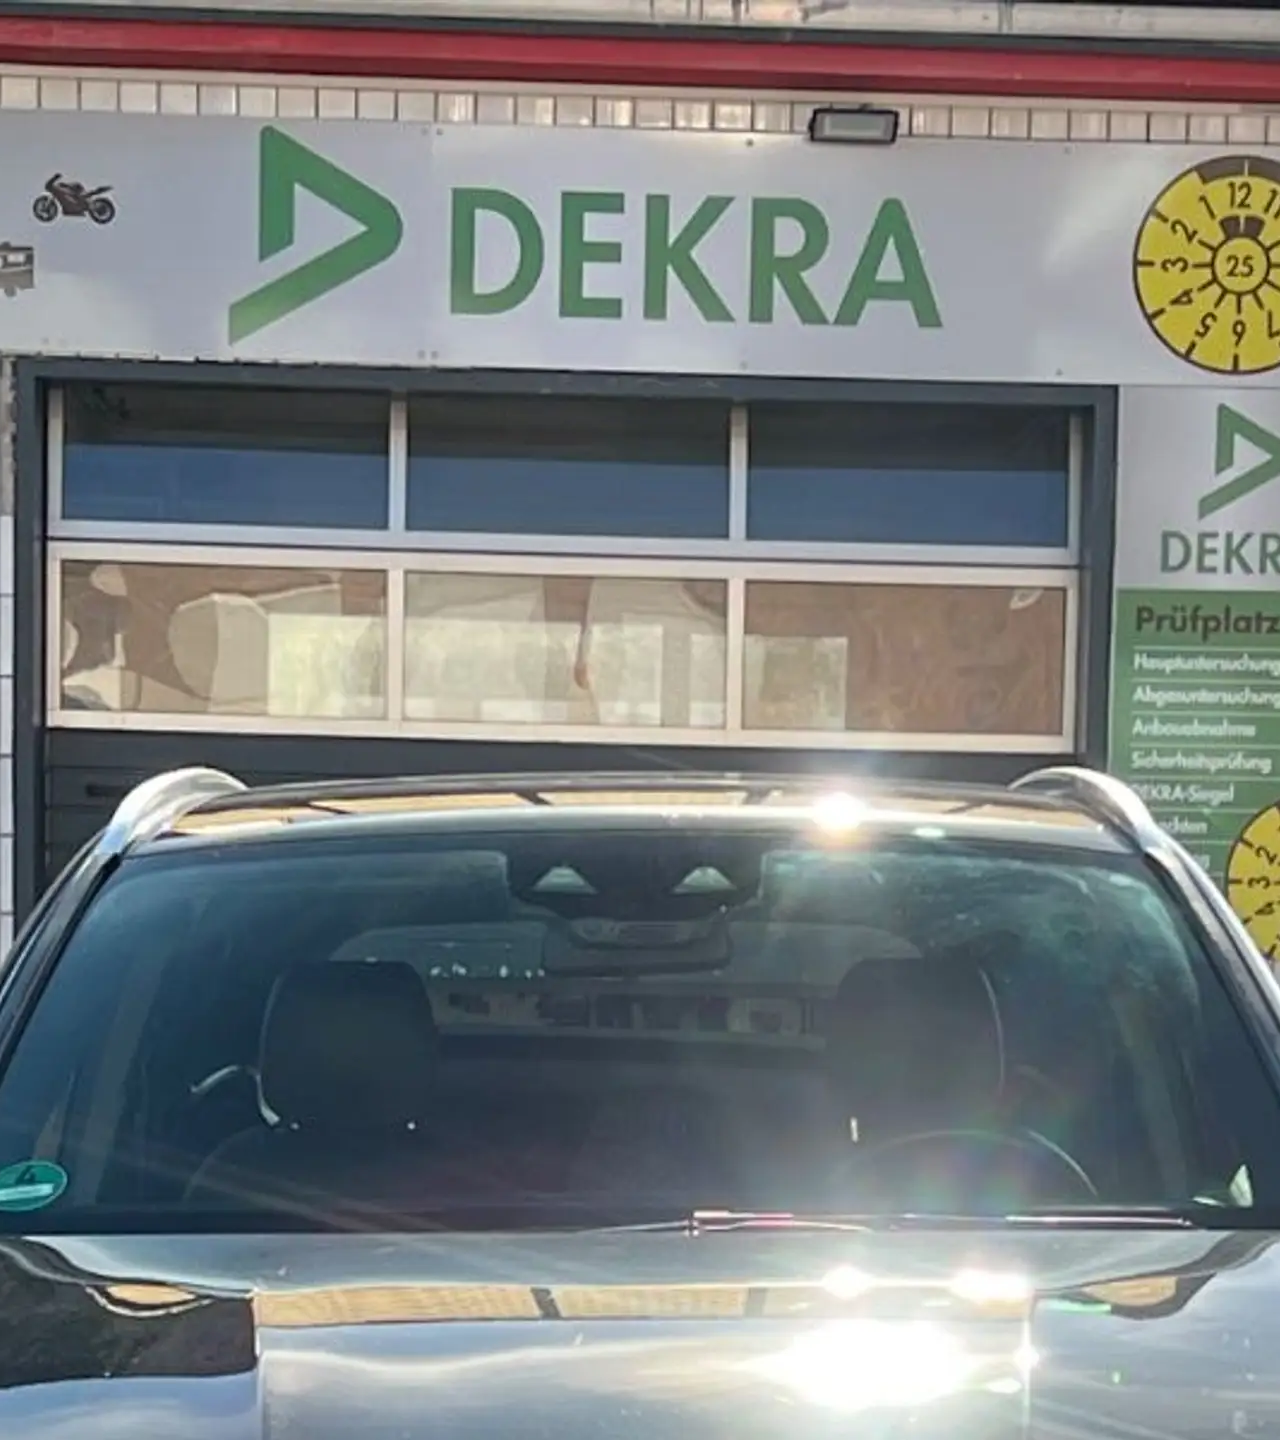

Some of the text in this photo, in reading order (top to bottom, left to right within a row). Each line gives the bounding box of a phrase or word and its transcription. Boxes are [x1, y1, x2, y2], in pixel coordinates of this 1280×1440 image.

[1198, 194, 1216, 221] 1
[1228, 181, 1252, 209] 12
[1170, 218, 1198, 244] 2
[449, 186, 944, 328] DEKRA
[1161, 257, 1189, 273] 3
[1226, 255, 1254, 277] 25
[1169, 288, 1194, 306] 4
[1195, 311, 1218, 339] 5
[1131, 749, 1272, 774] Sicherheitsprüfung
[1254, 846, 1278, 865] 2
[1248, 876, 1271, 889] 3
